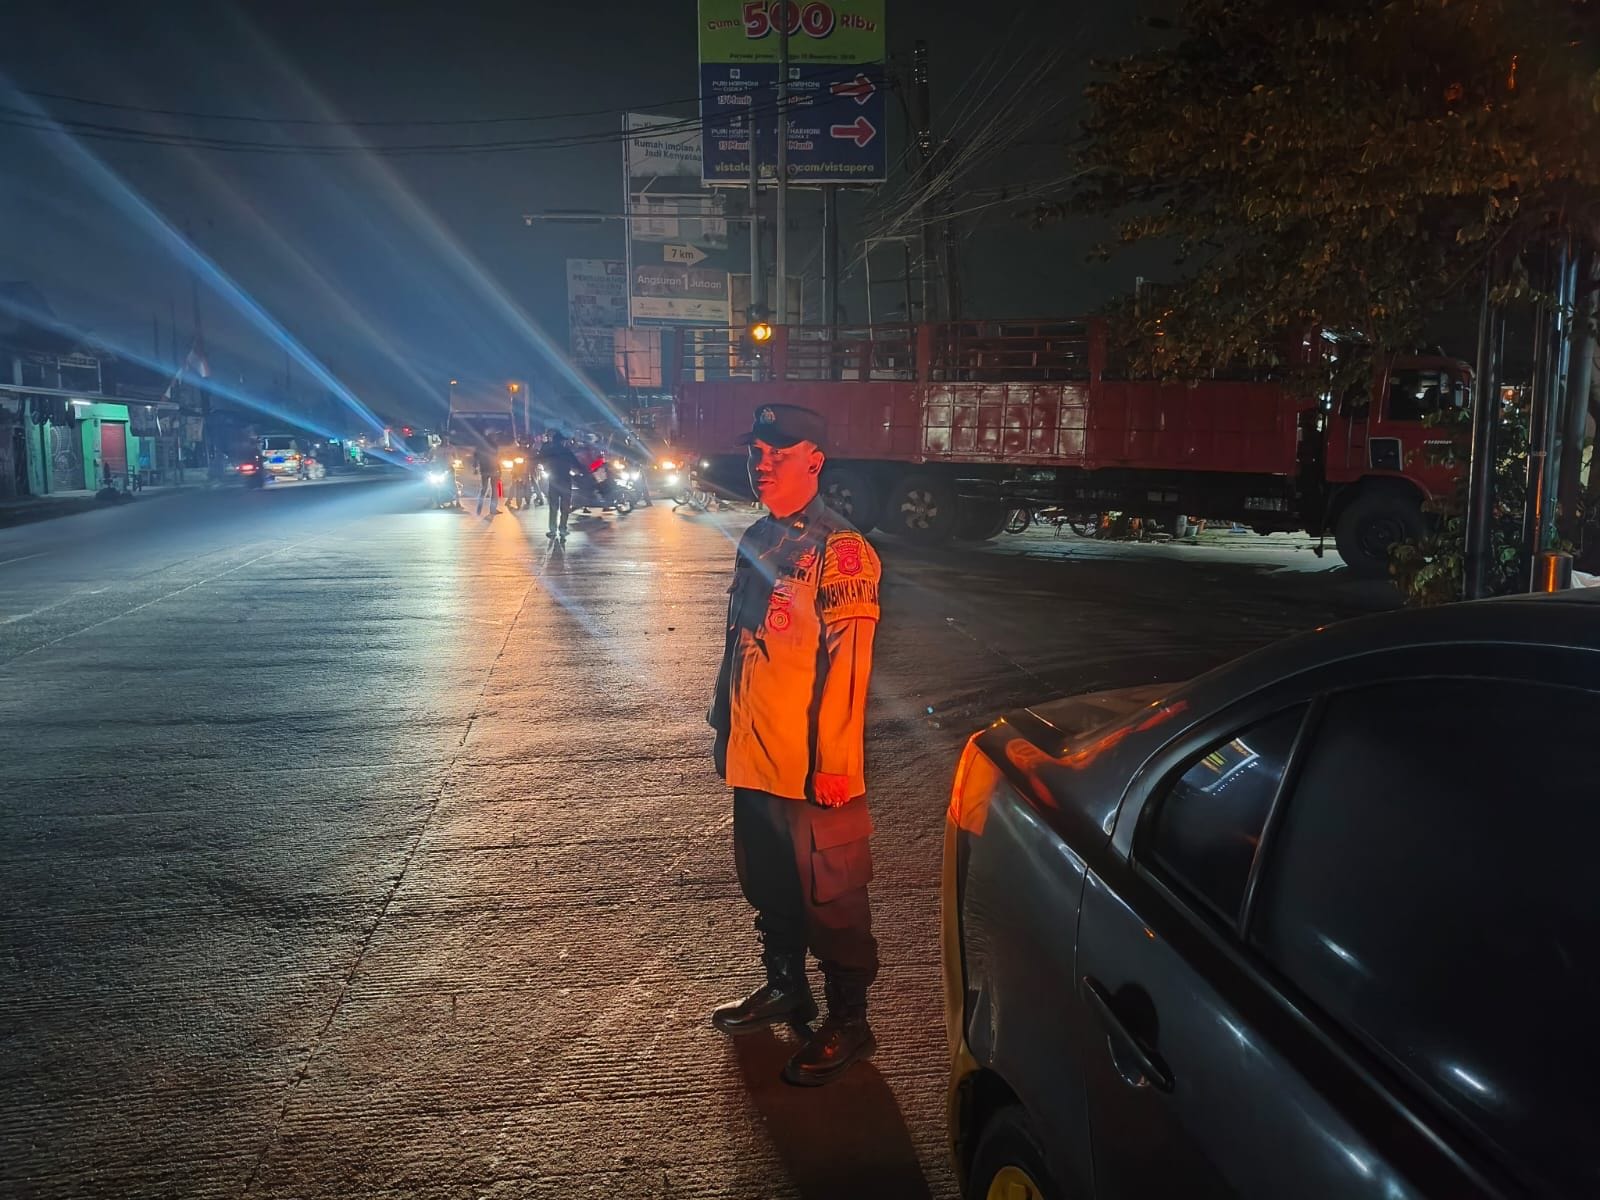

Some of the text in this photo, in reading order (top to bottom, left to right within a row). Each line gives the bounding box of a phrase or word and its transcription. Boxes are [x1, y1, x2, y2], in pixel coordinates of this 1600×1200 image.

[707, 1, 877, 38] Cuma 500 Ribu
[633, 138, 663, 149] Rumah
[645, 149, 662, 158] Jadi
[671, 249, 695, 260] 7 km
[638, 274, 682, 289] Angsuran
[681, 273, 689, 291] 1
[689, 279, 723, 290] Jutaan
